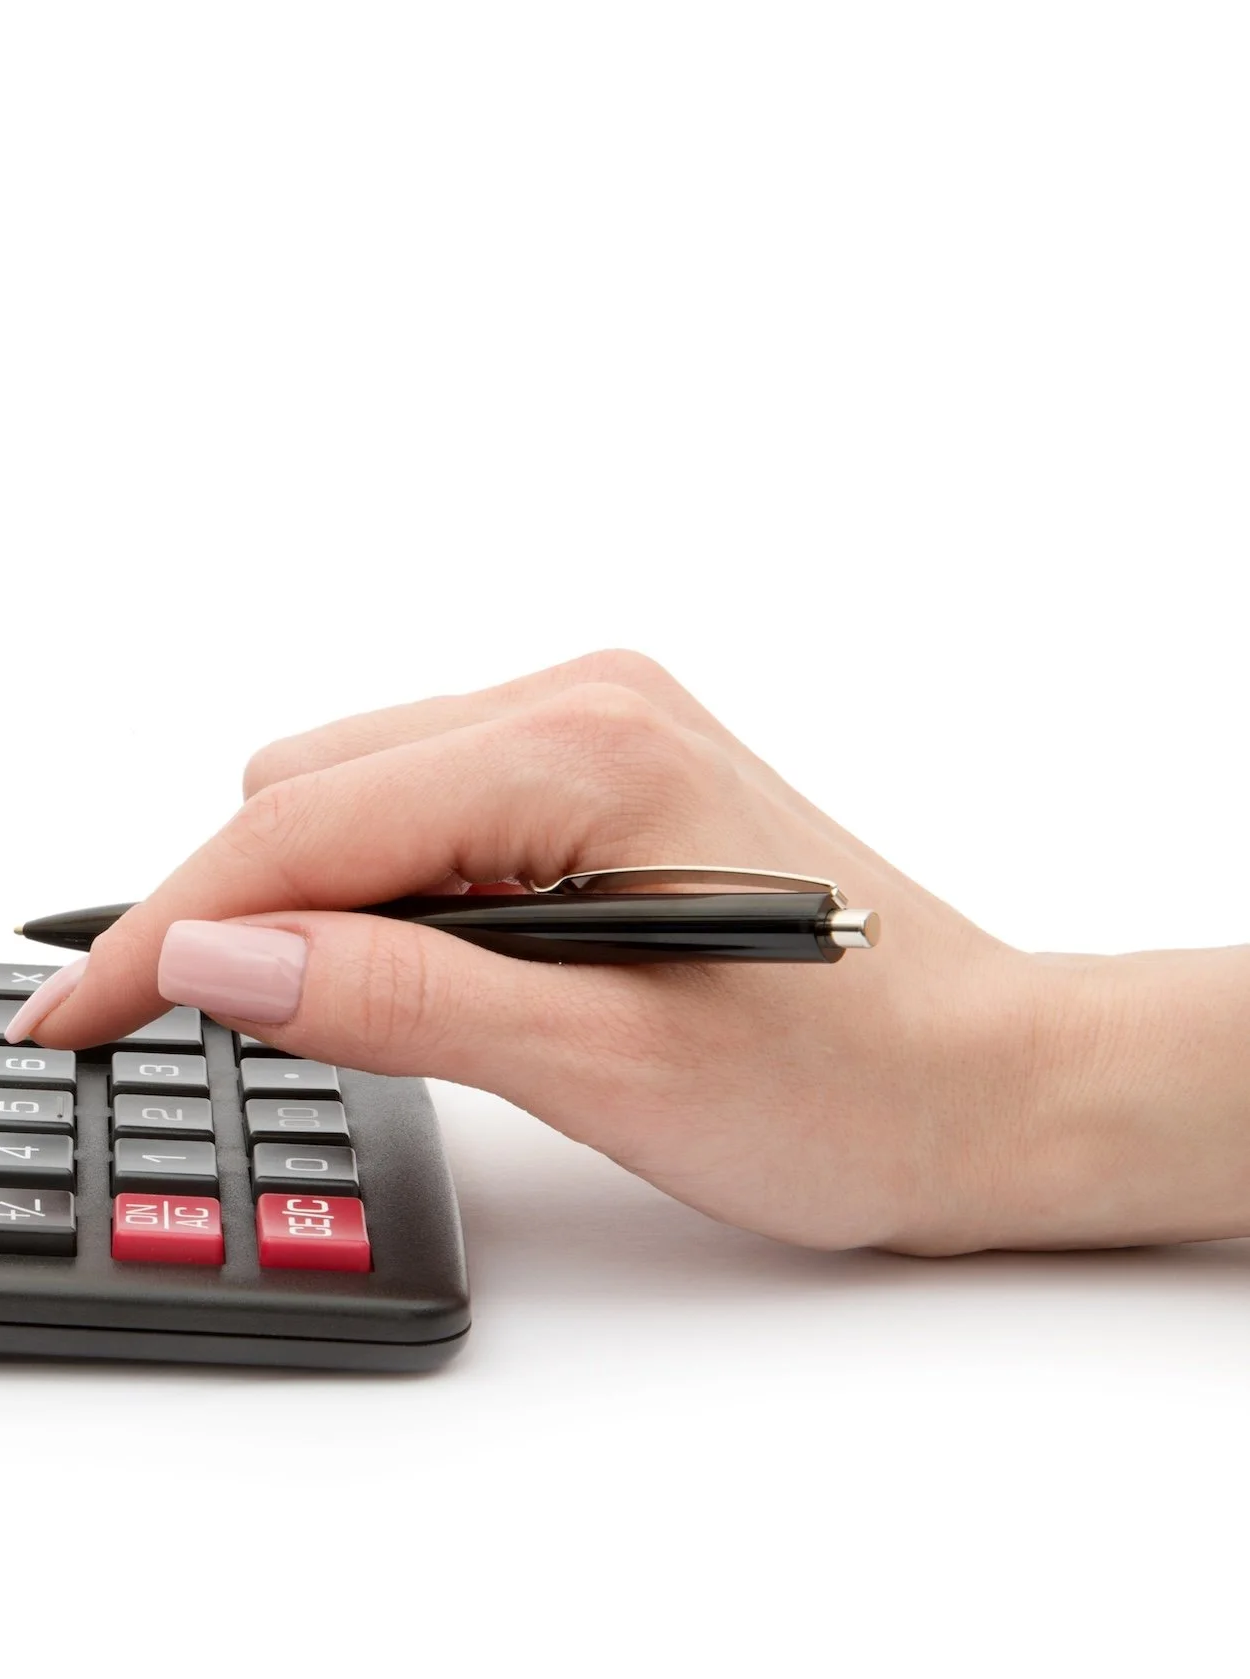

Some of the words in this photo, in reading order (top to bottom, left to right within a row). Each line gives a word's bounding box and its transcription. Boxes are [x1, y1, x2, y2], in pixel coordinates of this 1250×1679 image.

[6, 1058, 46, 1071] 6
[139, 1065, 179, 1077] 3
[142, 1108, 183, 1122] 2
[277, 1107, 321, 1129] 00
[142, 1154, 187, 1163] 1
[285, 1157, 329, 1172] 0
[125, 1203, 159, 1225] ON
[175, 1207, 209, 1229] AC
[281, 1198, 335, 1236] CE/C
